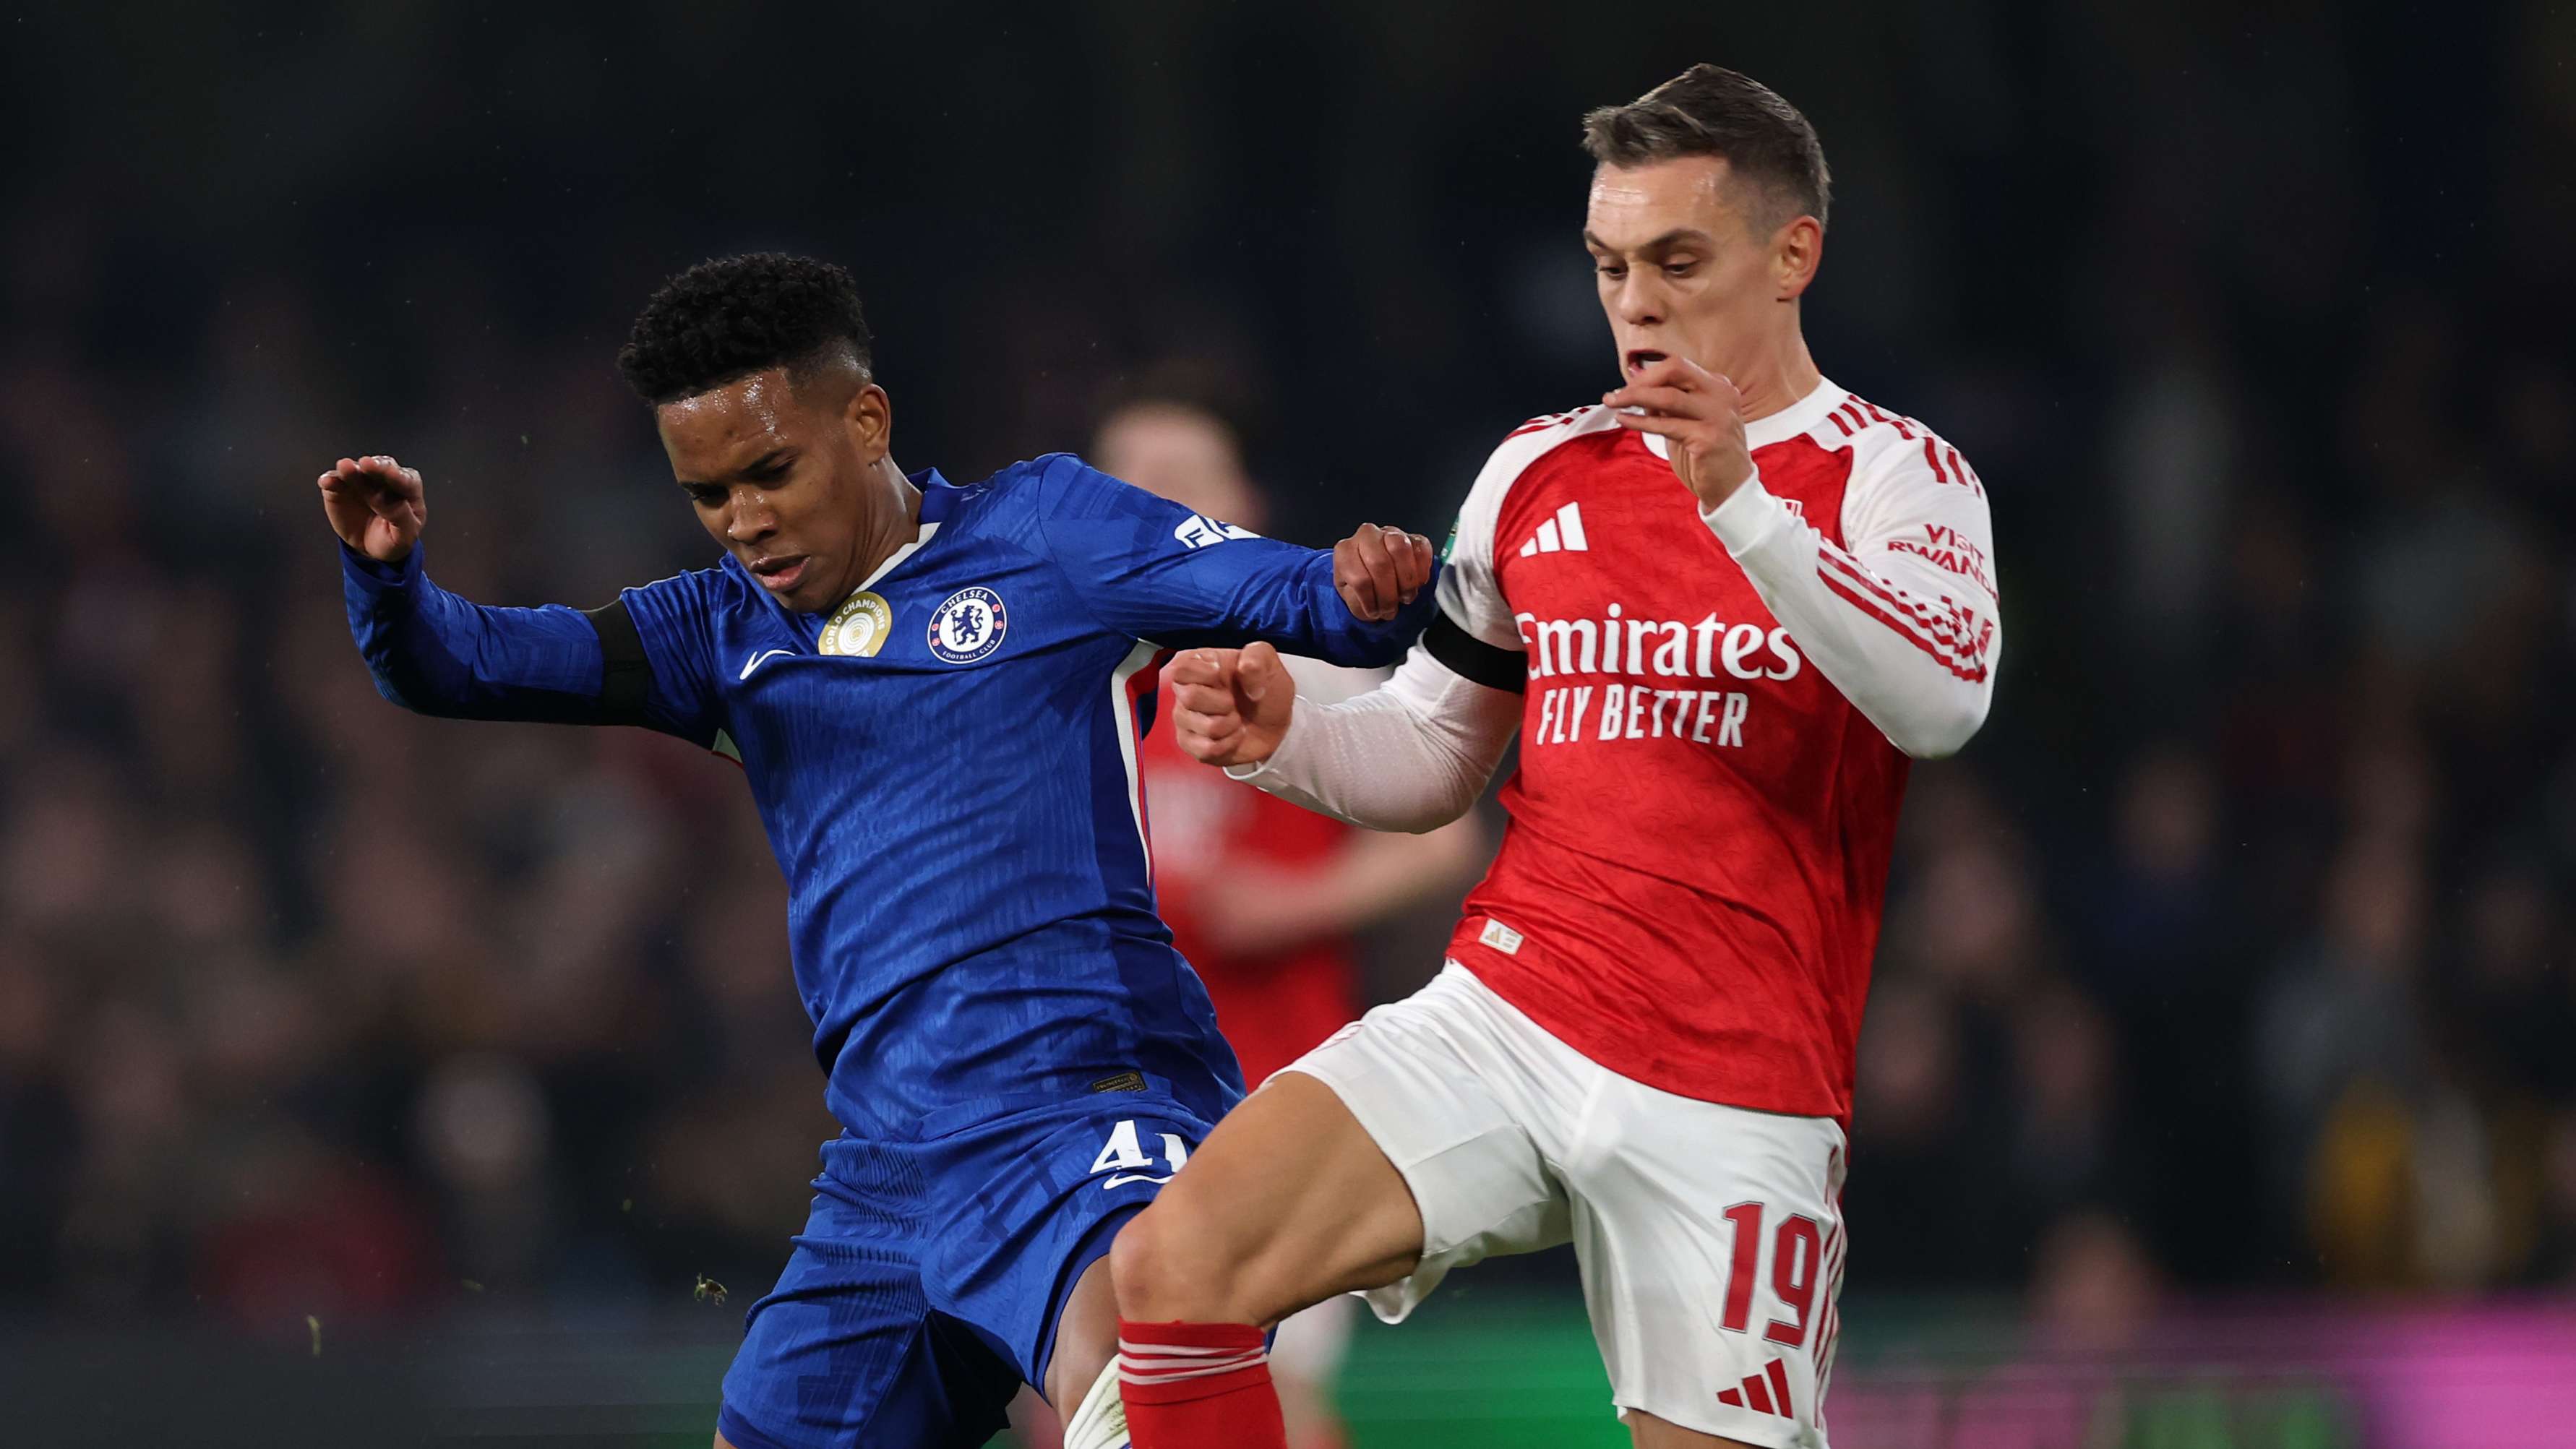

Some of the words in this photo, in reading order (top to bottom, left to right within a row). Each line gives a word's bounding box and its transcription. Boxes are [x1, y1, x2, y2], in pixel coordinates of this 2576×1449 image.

[1924, 523, 1985, 567] VISIT
[843, 599, 885, 630] CHAMPIONS
[941, 590, 988, 614] CHELSEA
[943, 650, 976, 660] FOOTBALL
[979, 640, 996, 654] CLUB
[1515, 603, 1800, 681] Emirates
[1537, 686, 1594, 745] FLY
[1598, 684, 1749, 747] BETTER
[1090, 1119, 1188, 1174] 41
[1719, 1200, 1821, 1349] 19
